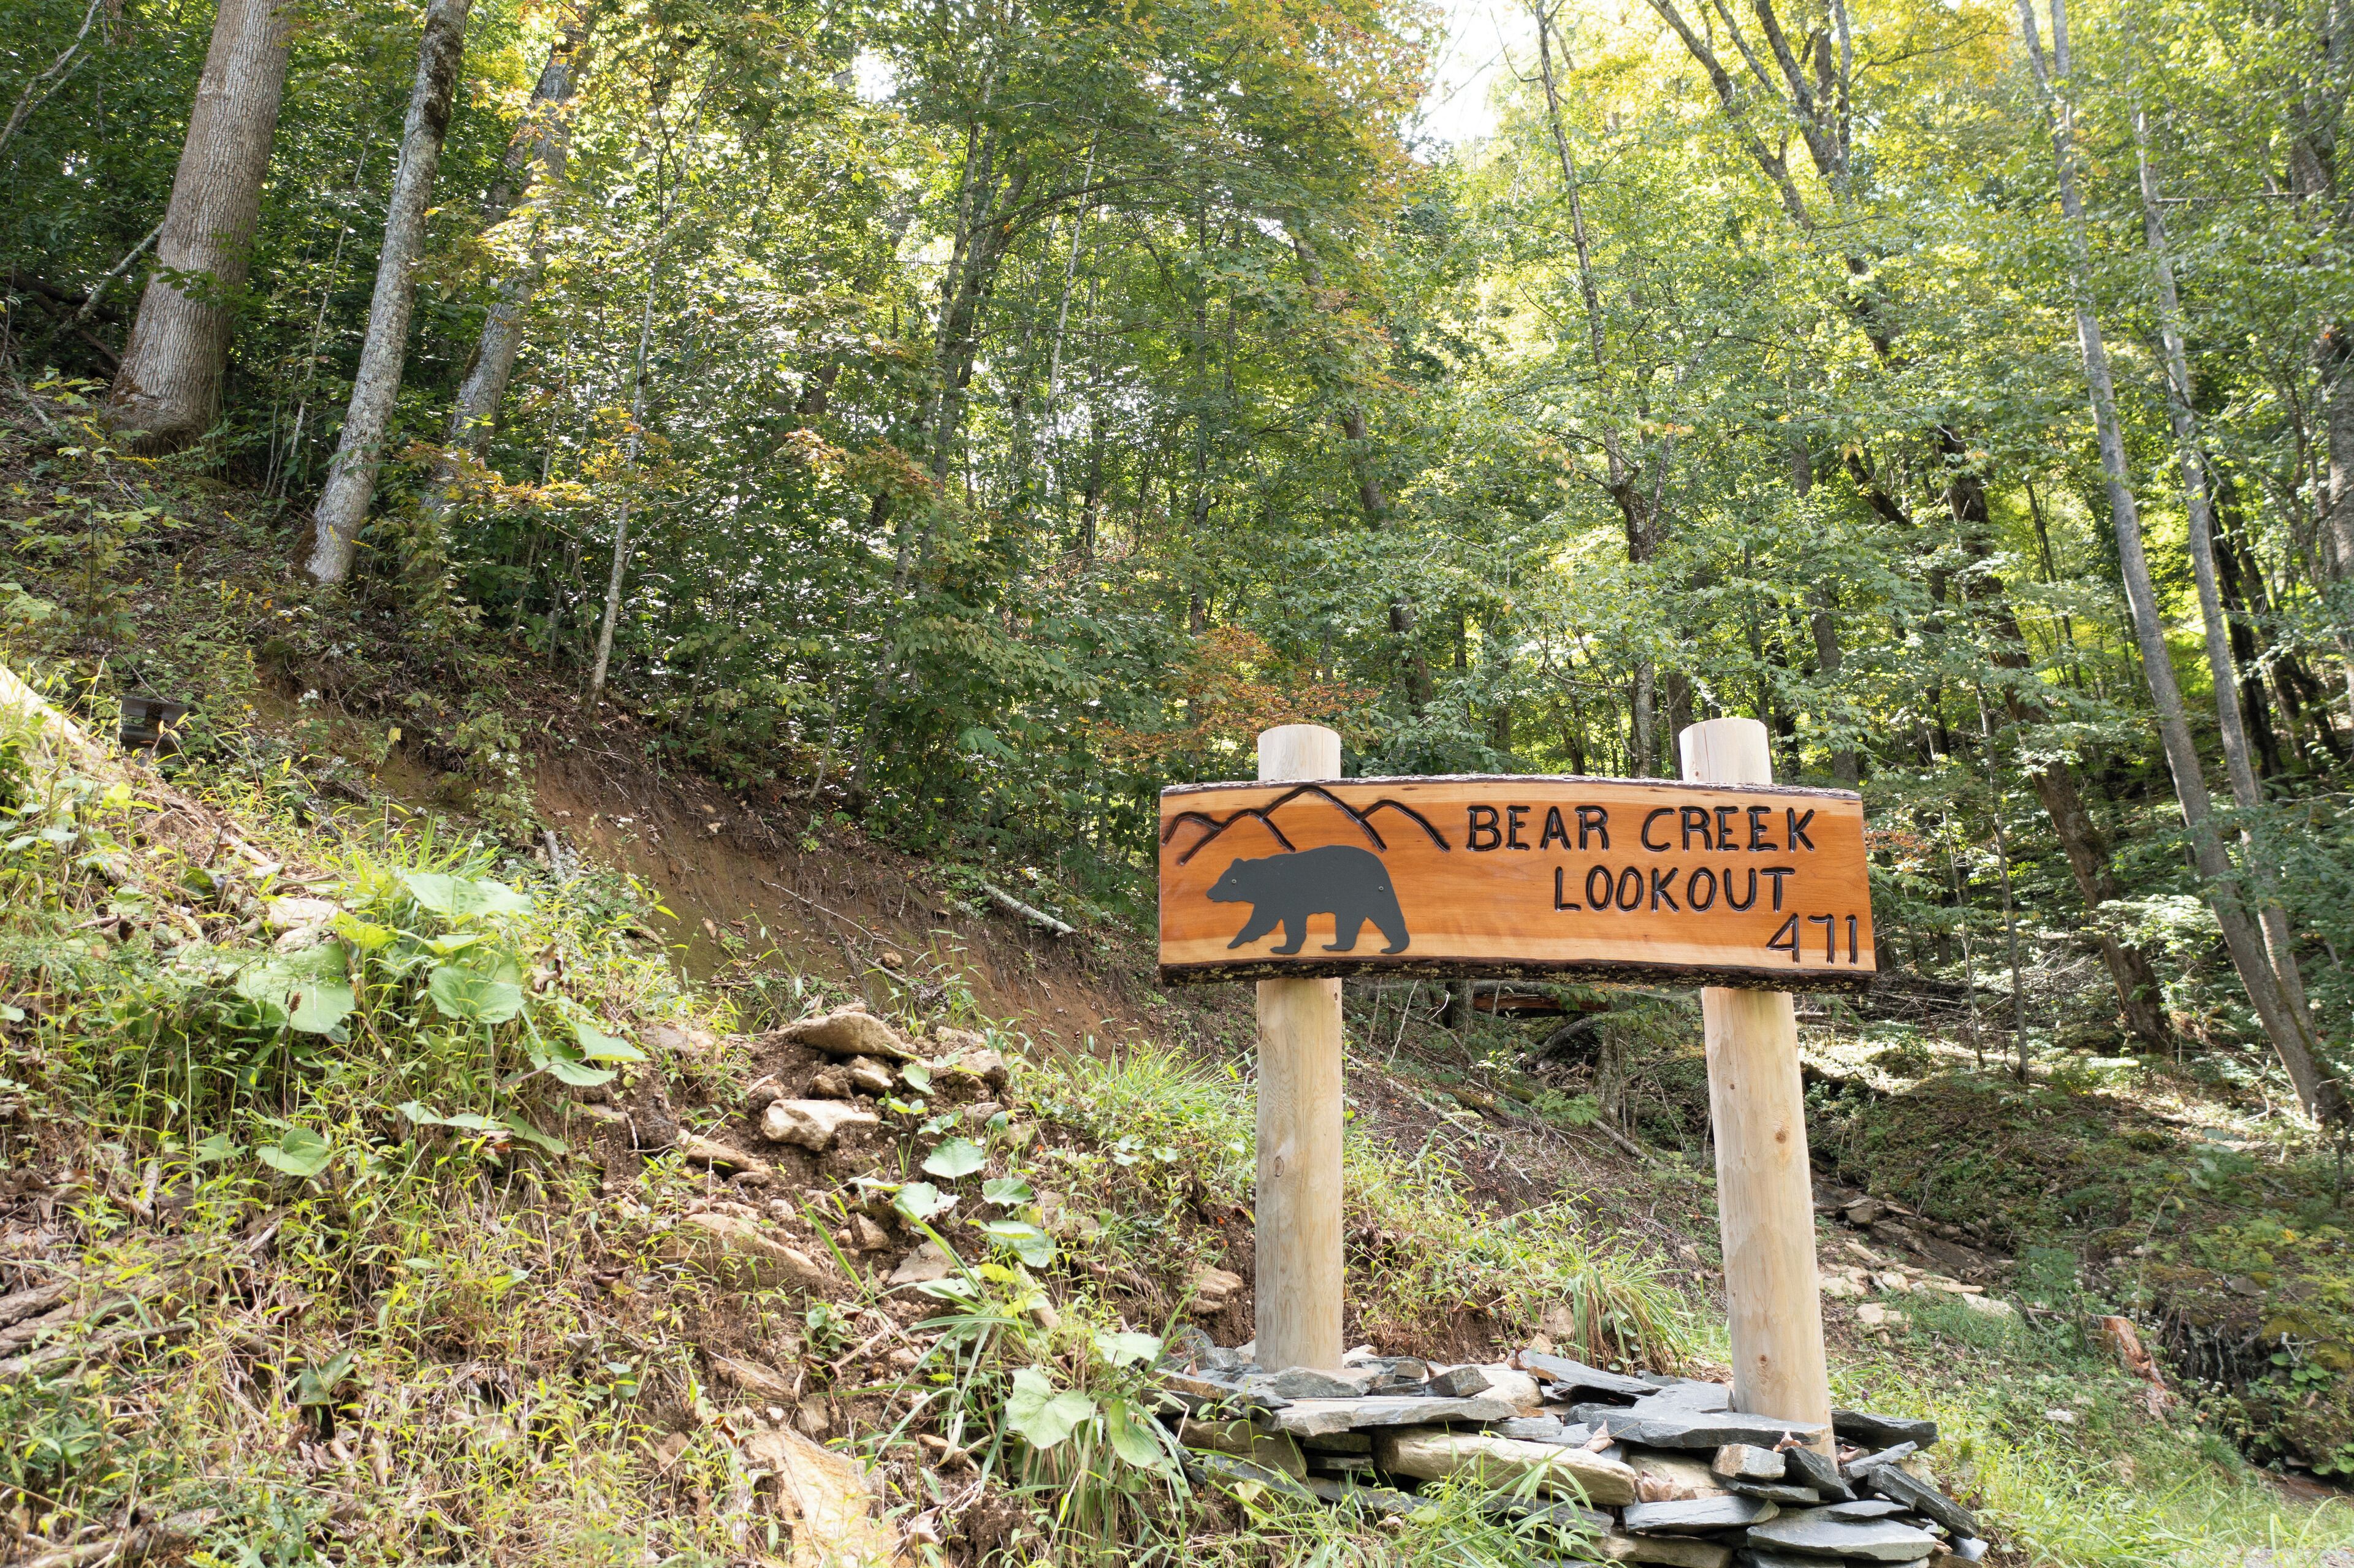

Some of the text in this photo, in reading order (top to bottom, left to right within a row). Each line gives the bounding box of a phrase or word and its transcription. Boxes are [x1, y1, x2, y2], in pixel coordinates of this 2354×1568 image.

[1466, 805, 1816, 853] BEAR CREEK
[1554, 864, 1796, 912] LOOKOUT
[1766, 912, 1859, 965] 471
